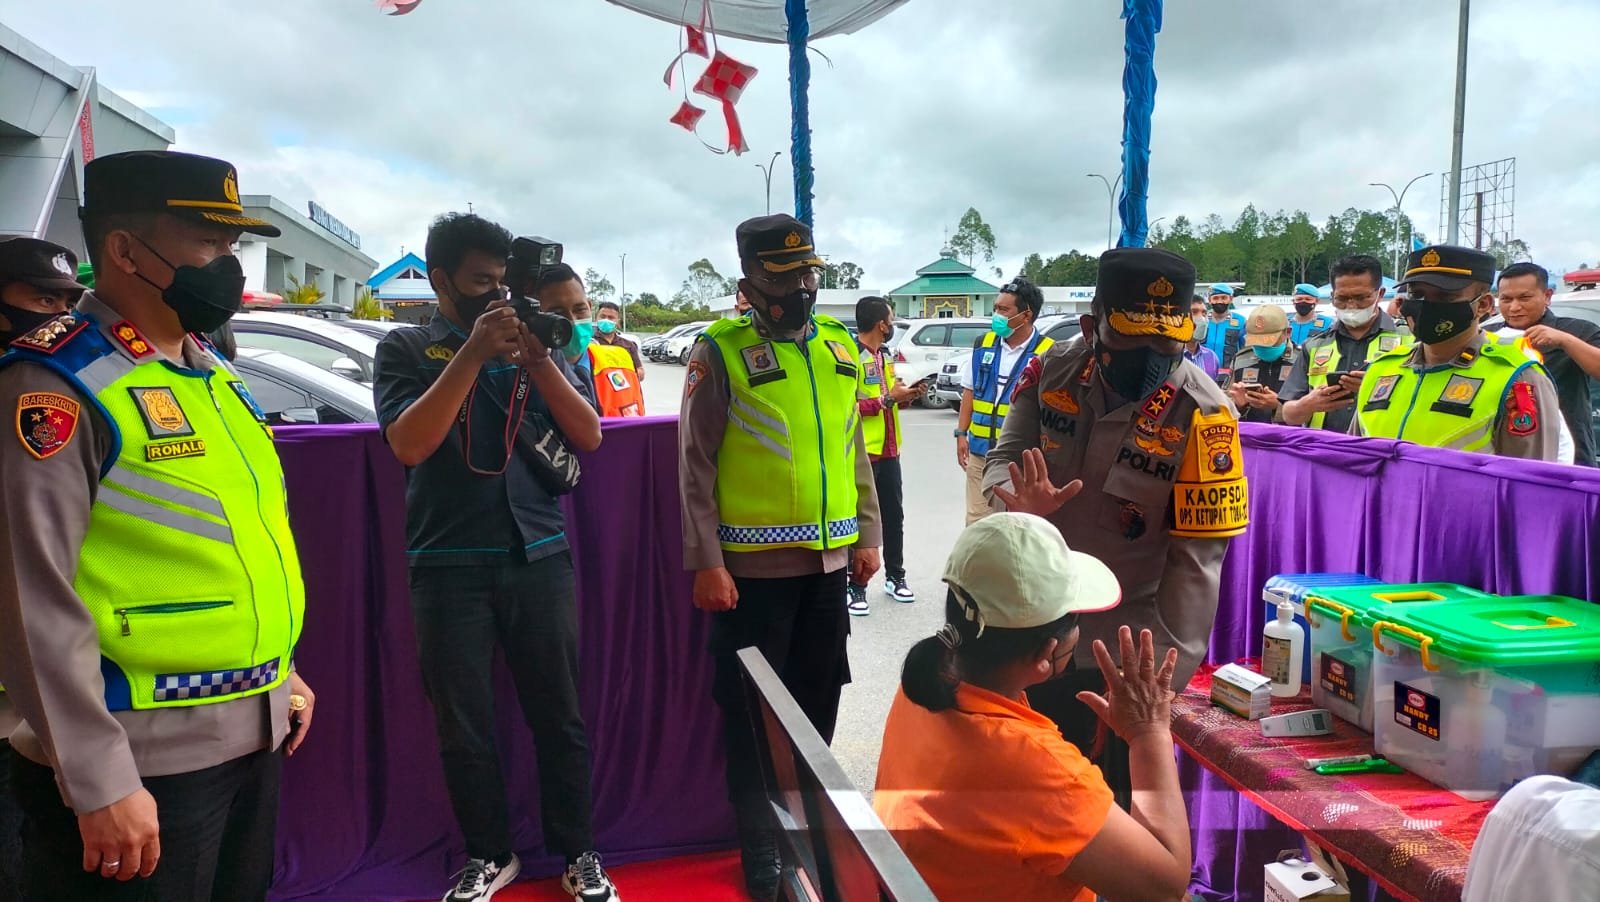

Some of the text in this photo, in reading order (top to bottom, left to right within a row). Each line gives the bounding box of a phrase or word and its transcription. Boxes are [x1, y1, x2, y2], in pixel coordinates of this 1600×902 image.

[22, 395, 76, 414] BARESKRIM
[1203, 426, 1232, 437] POLDA
[150, 440, 205, 458] RONALD
[1117, 447, 1175, 482] POLRI
[1180, 507, 1193, 526] OPS
[1196, 507, 1227, 526] KETUPAT
[1403, 704, 1430, 721] HANDY
